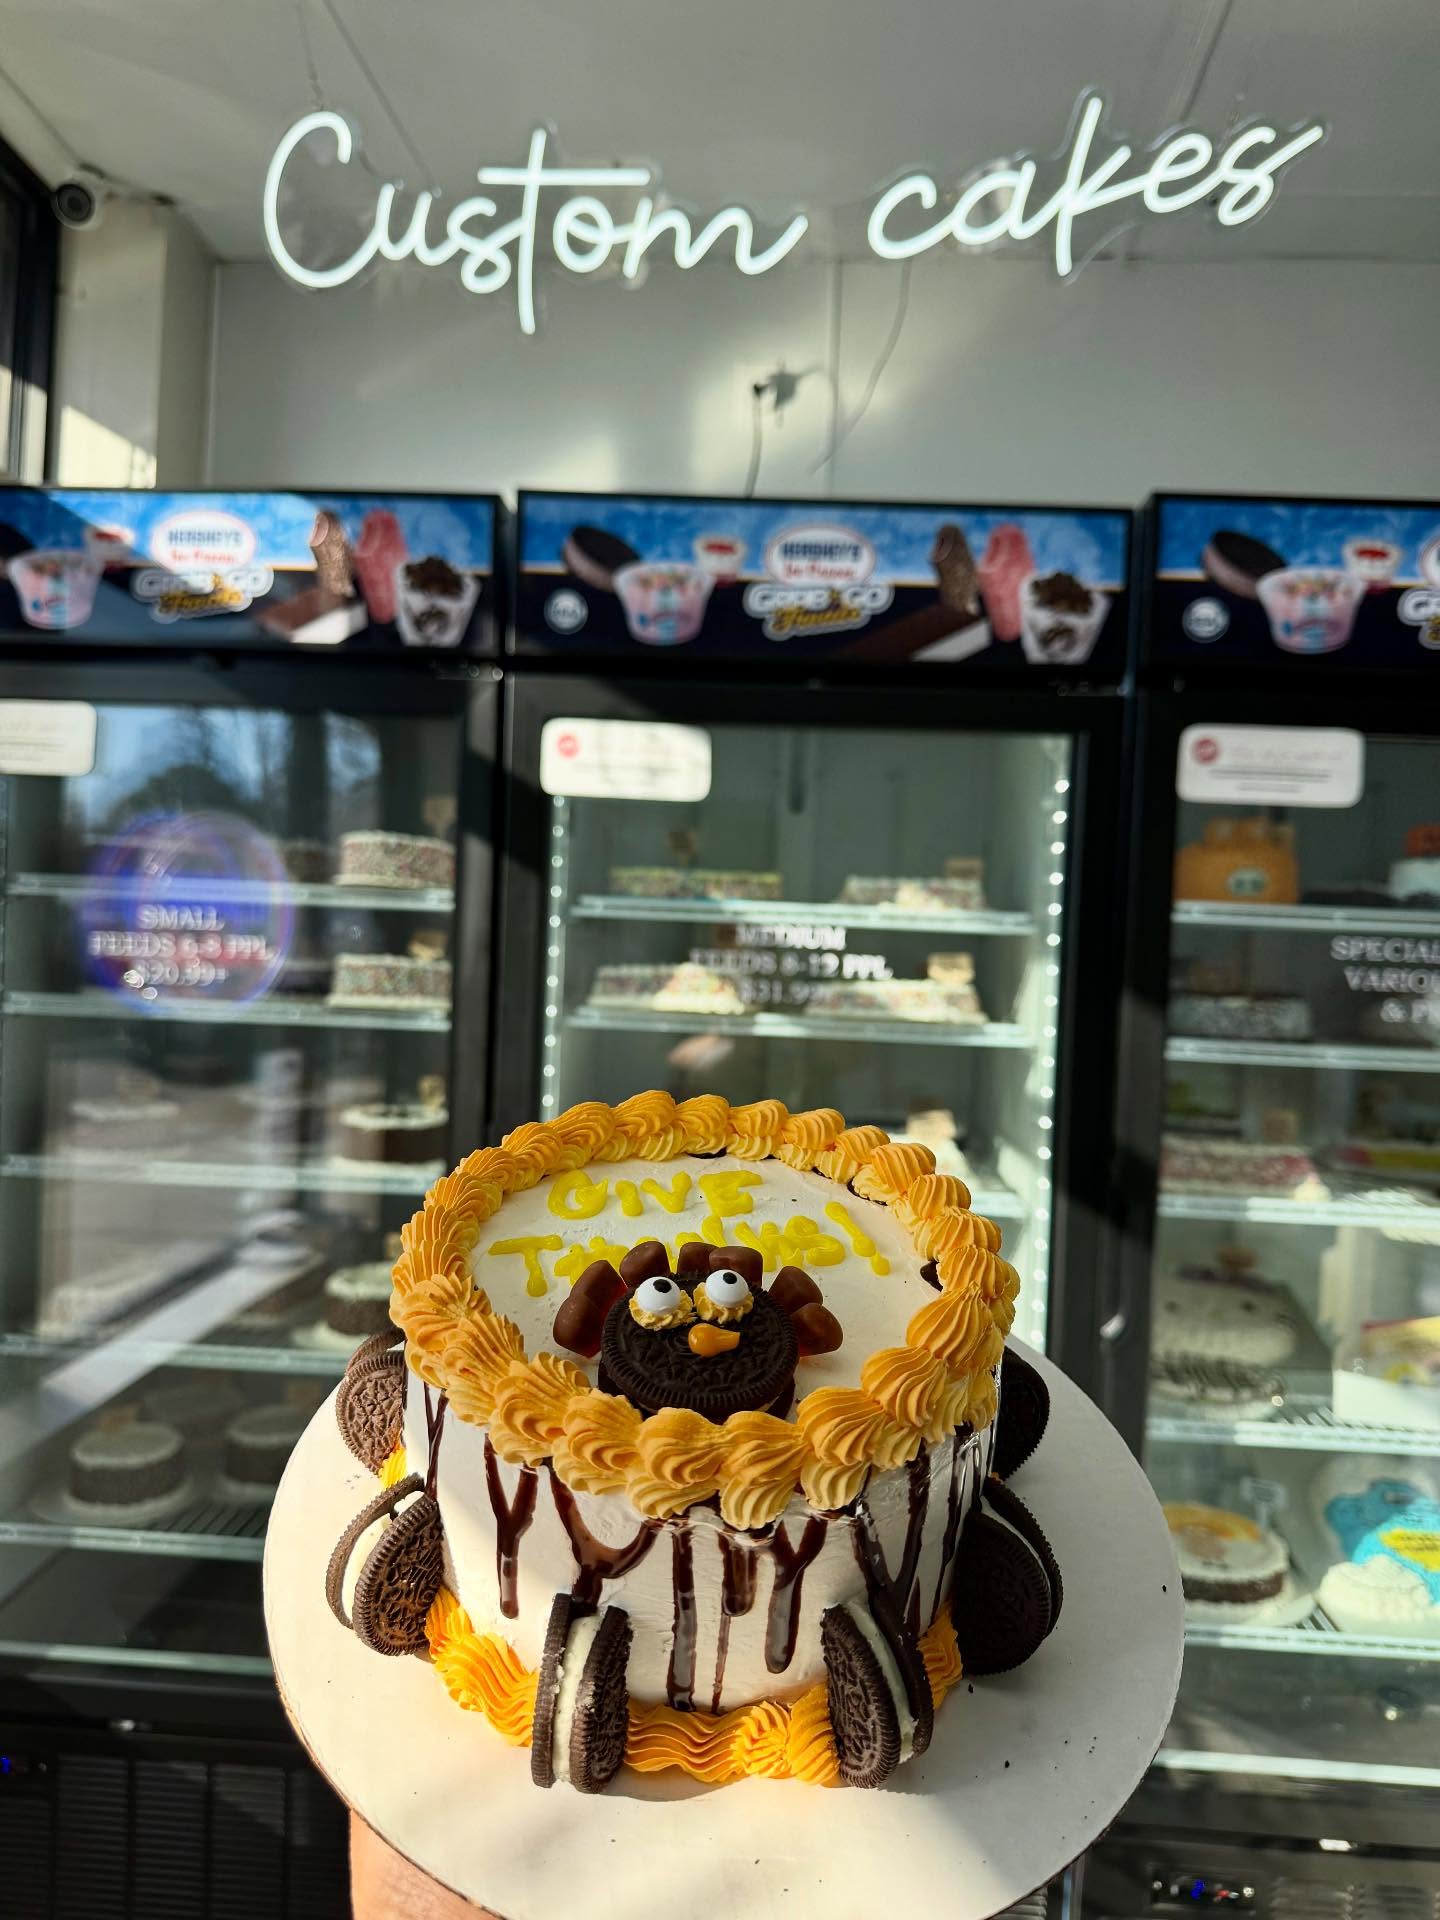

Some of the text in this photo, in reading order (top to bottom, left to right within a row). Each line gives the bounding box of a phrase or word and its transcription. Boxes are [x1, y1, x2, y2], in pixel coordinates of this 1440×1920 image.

[263, 97, 1324, 335] Custom cakes
[547, 1169, 763, 1220] GIVE
